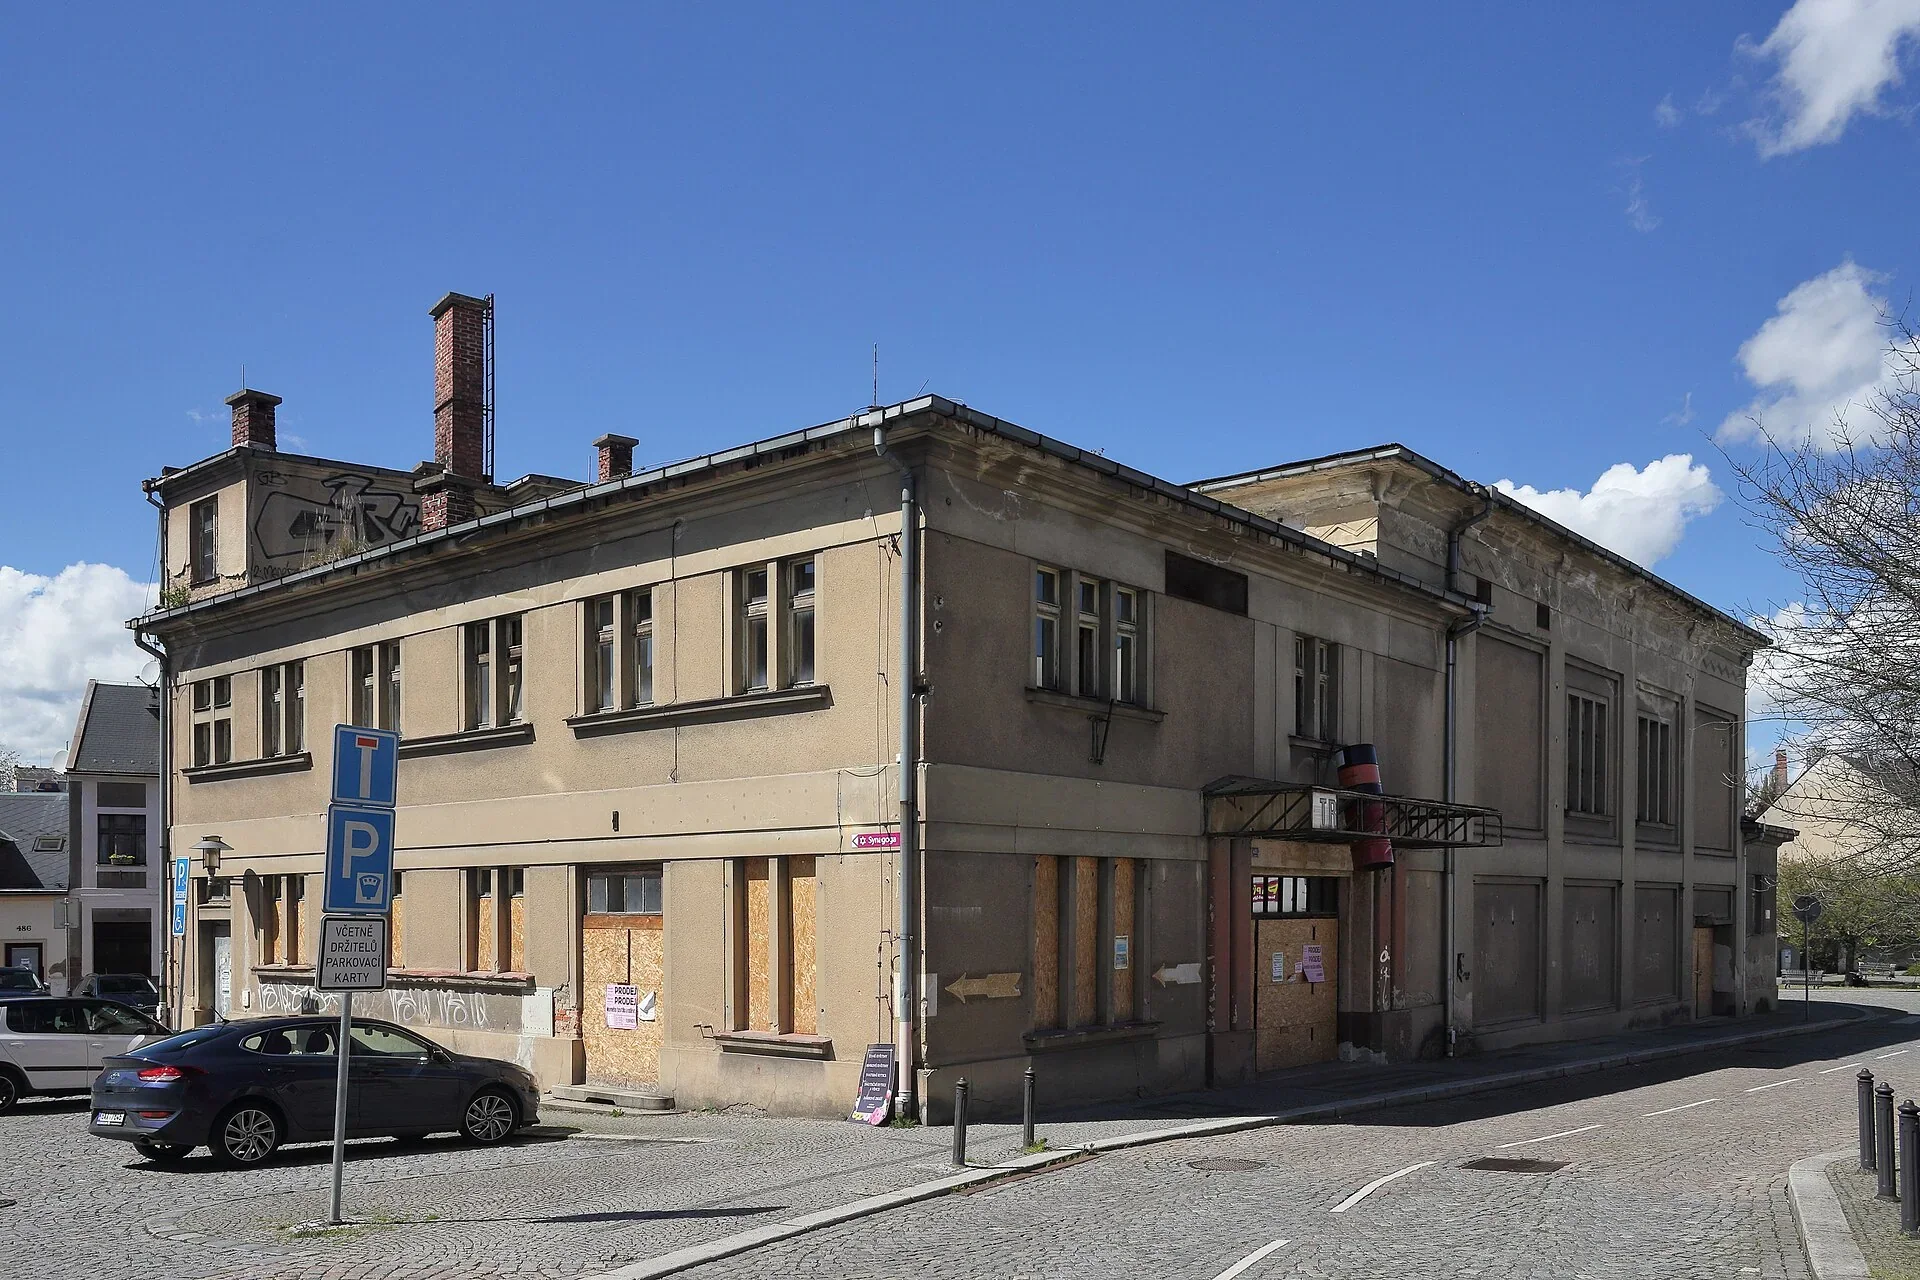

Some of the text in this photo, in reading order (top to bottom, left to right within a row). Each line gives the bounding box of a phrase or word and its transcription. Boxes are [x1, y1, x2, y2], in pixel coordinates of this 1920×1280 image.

[868, 836, 897, 846] Synagoga
[342, 820, 379, 879] P
[178, 862, 185, 886] P
[336, 924, 373, 937] VČETNĚ
[331, 939, 378, 953] DRŽITELŮ
[325, 955, 381, 968] PARKOVACÍ
[334, 972, 370, 983] KARTY
